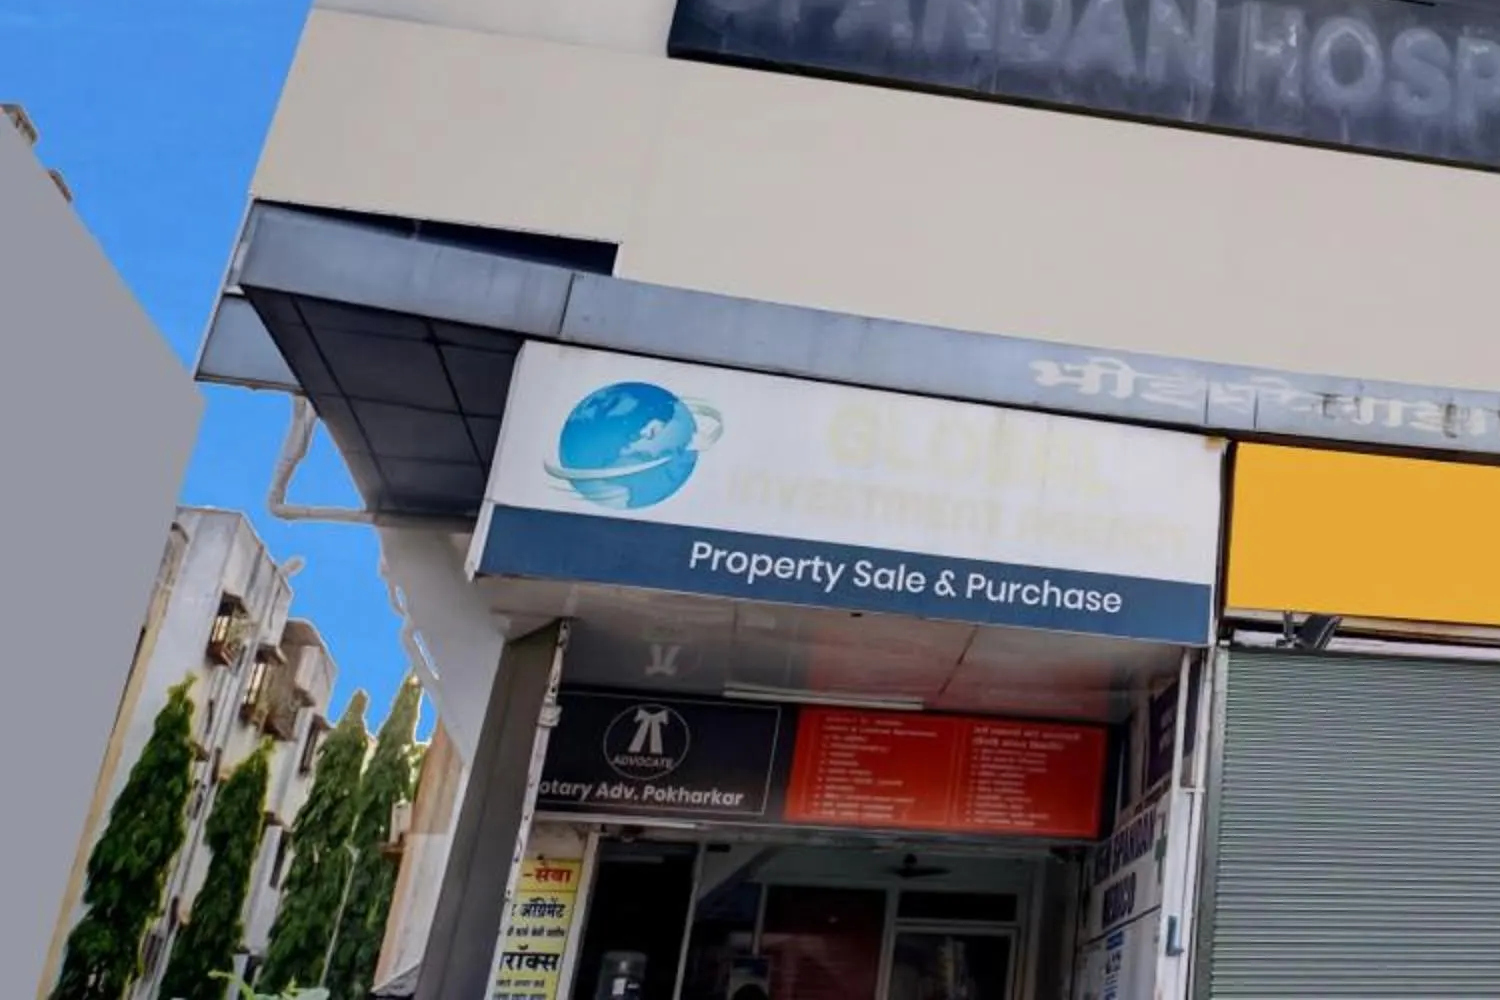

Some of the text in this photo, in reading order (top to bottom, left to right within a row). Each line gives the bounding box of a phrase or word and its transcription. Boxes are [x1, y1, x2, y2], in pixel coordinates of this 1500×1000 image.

[688, 541, 1123, 614] Property Sale & Purchase
[613, 754, 675, 771] ADVOCATE
[538, 780, 745, 807] otary Adv. Pokharkar
